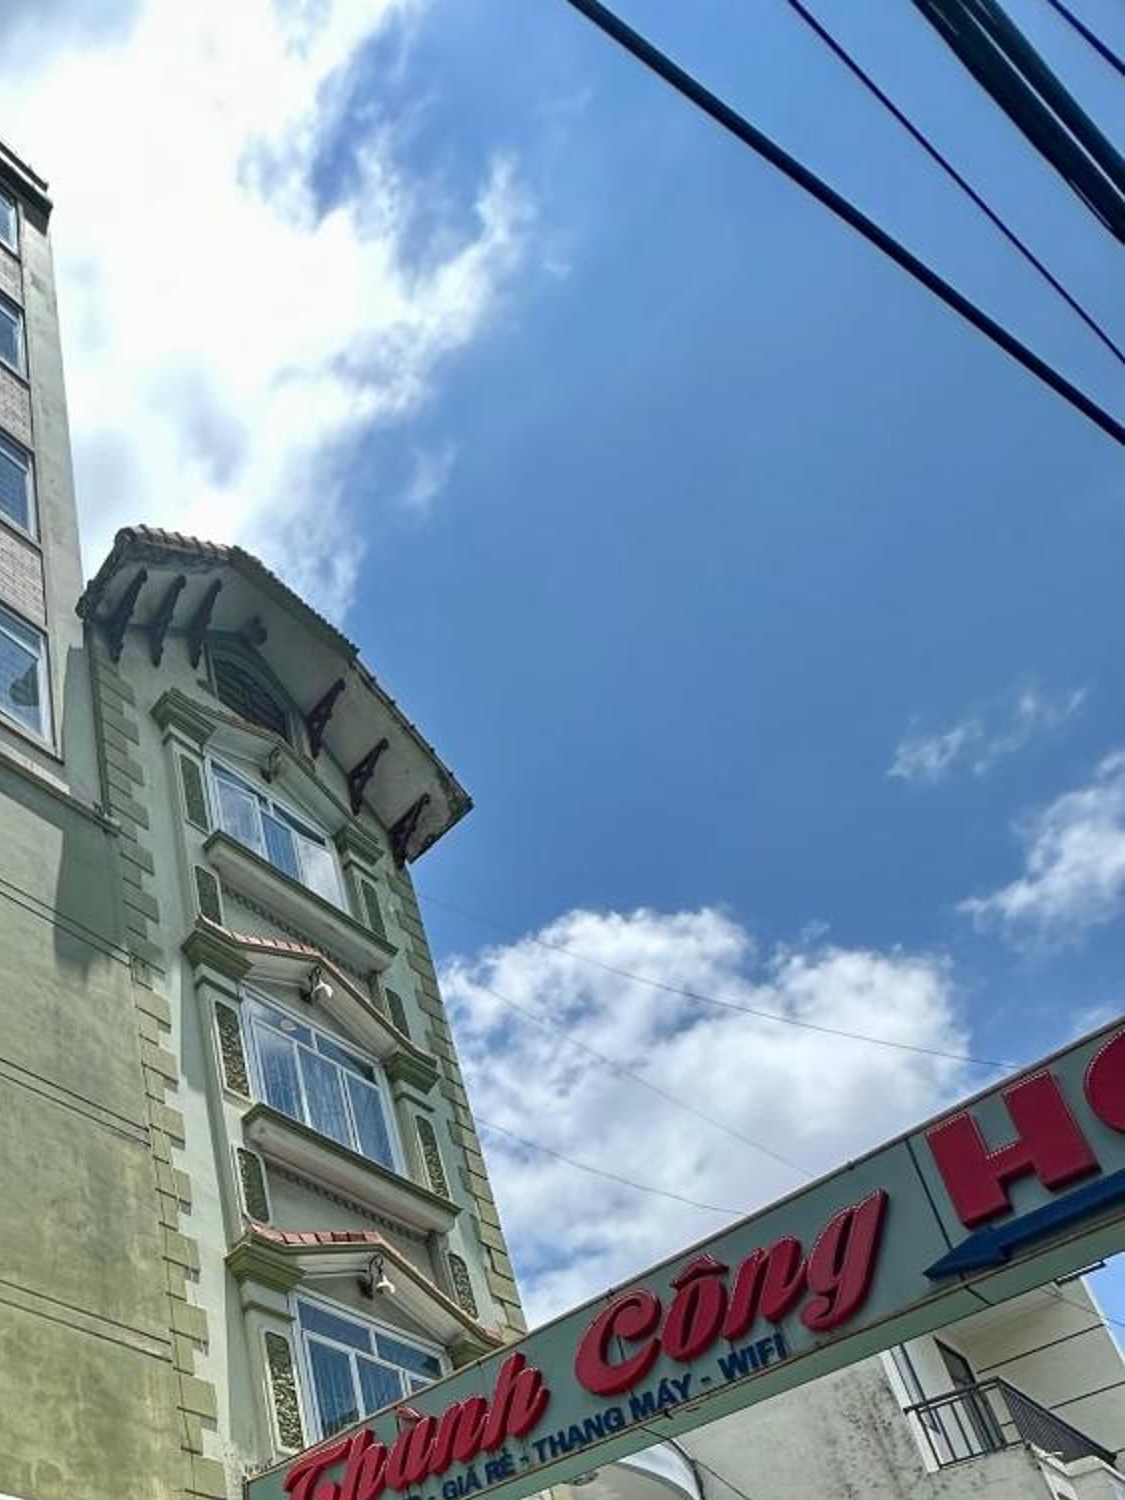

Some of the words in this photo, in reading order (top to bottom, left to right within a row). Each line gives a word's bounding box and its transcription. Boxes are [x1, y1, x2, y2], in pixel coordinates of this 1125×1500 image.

[574, 1187, 889, 1396] Công
[532, 1407, 626, 1463] THANG
[628, 1373, 692, 1422] MÁY
[717, 1333, 789, 1381] WIFI
